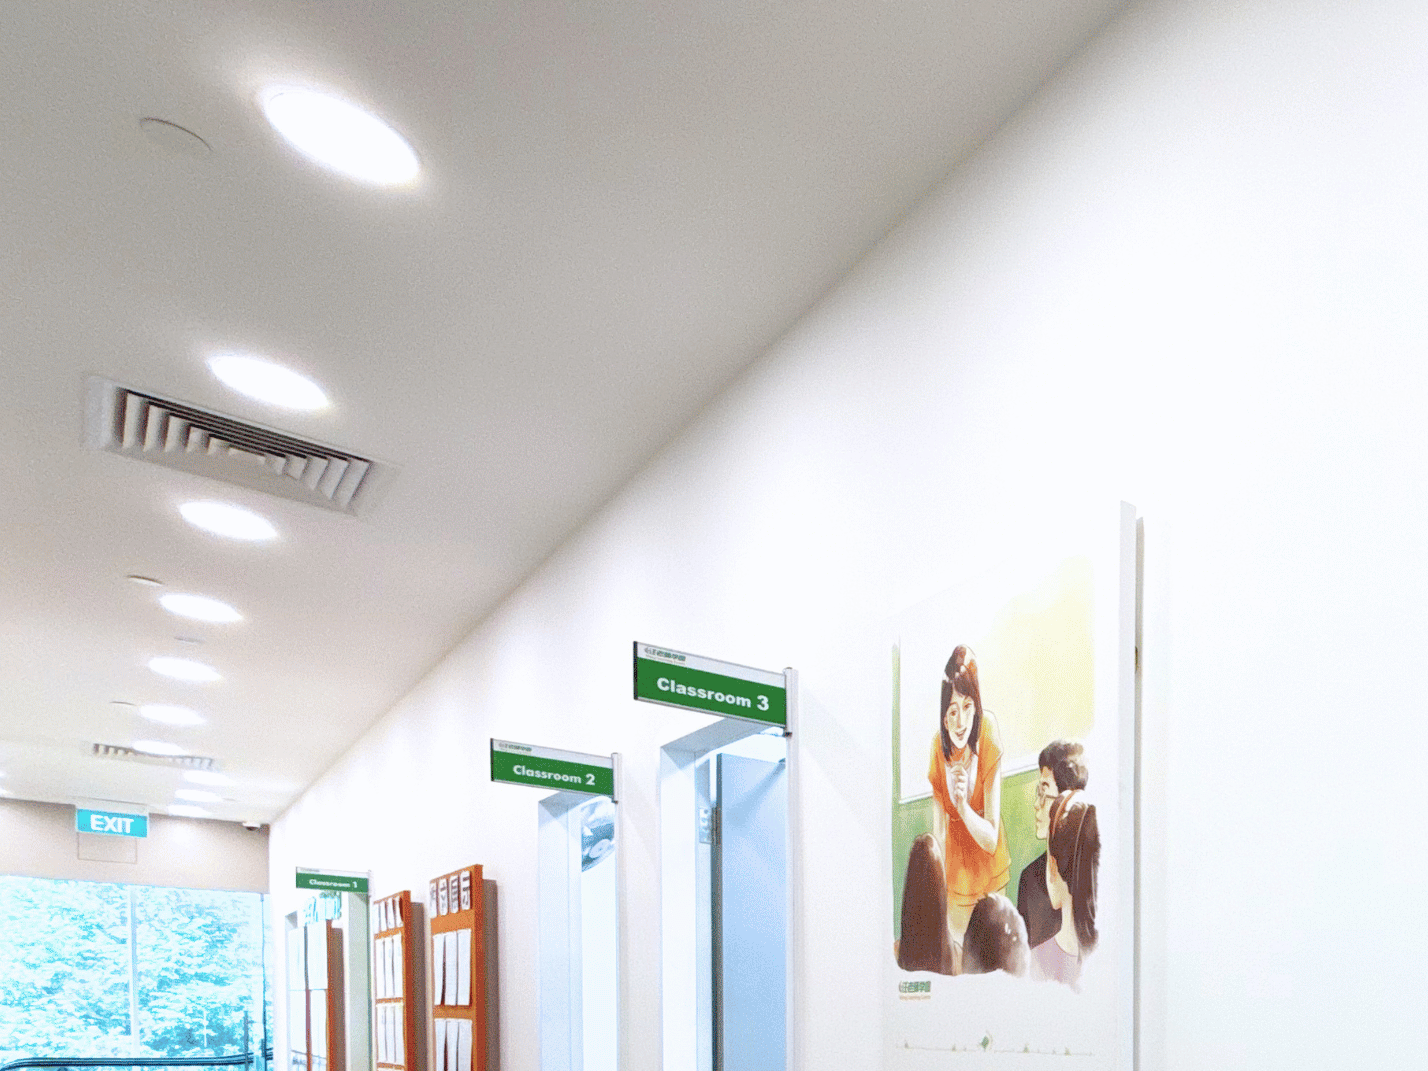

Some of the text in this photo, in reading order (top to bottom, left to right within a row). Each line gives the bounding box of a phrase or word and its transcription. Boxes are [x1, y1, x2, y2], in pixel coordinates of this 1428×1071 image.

[657, 677, 769, 711] Classroom 3
[513, 764, 595, 786] Classroom 2
[90, 813, 134, 834] EXIT
[309, 878, 350, 888] Classroom
